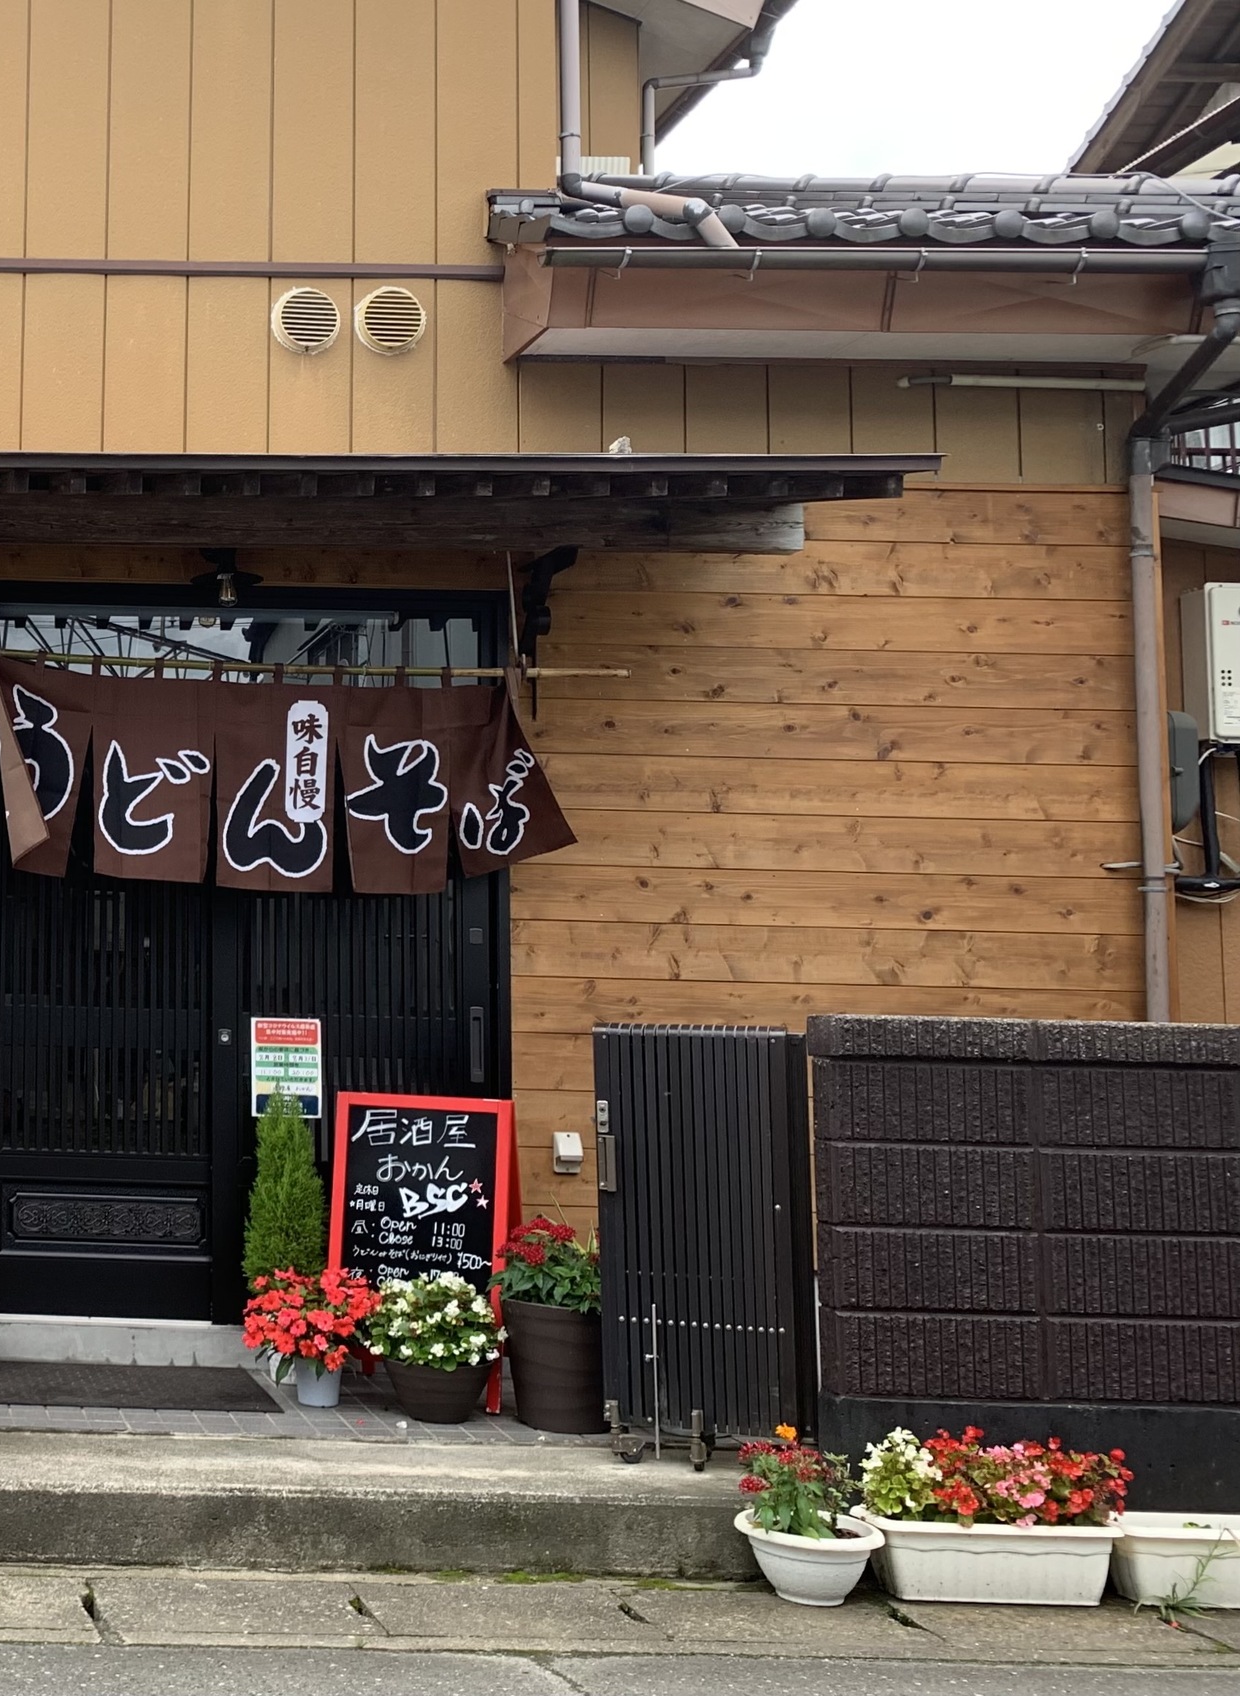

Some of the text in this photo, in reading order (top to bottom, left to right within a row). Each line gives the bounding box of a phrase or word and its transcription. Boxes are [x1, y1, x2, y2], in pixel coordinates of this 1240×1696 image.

[289, 713, 323, 813] 味自慢
[351, 1109, 477, 1149] 居酒屋
[376, 1153, 464, 1182] おかん
[354, 1183, 379, 1196] 定休日
[398, 1182, 469, 1220] BSC
[380, 1216, 417, 1233] Open
[433, 1221, 466, 1238] 11:00
[378, 1232, 463, 1251] Close 13:00
[377, 1263, 410, 1279] Open
